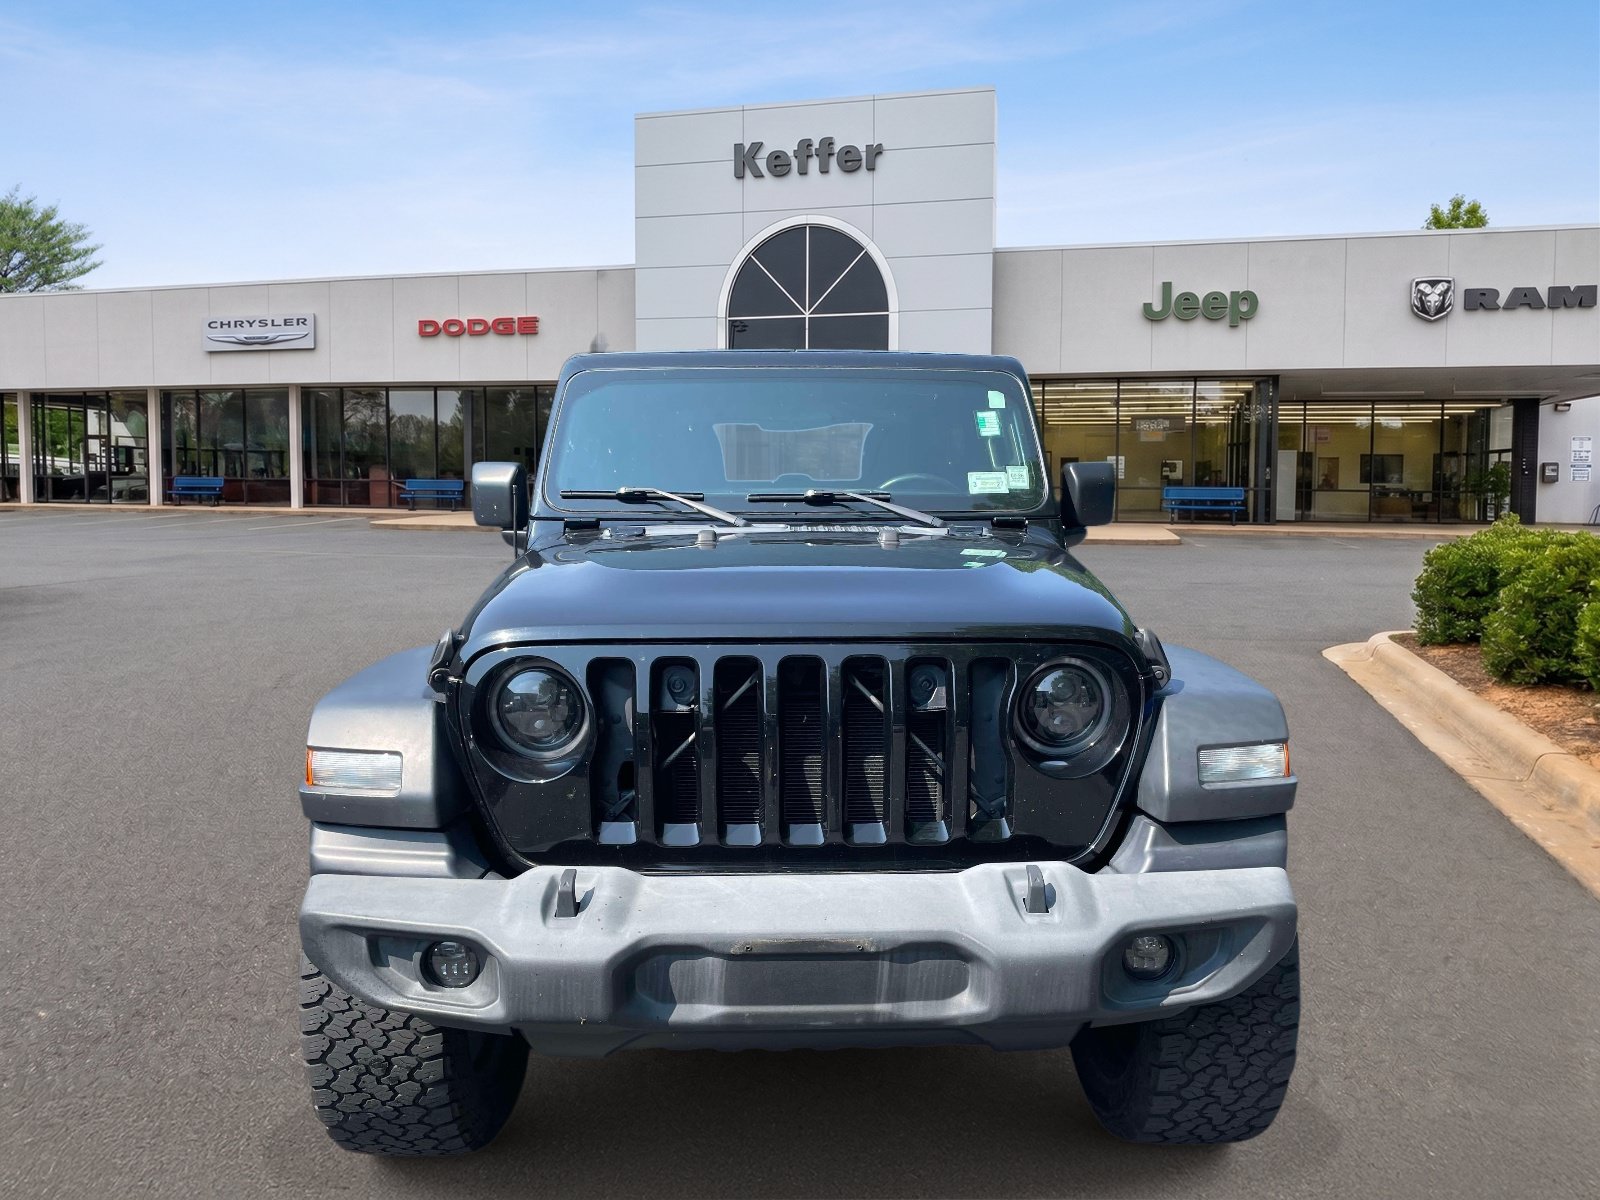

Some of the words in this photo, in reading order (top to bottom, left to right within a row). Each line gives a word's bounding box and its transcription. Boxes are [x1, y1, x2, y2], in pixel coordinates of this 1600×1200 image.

[734, 137, 883, 178] Keffer
[1143, 281, 1259, 327] Jeep
[1464, 285, 1598, 310] RAM
[208, 317, 307, 329] CHRYSLER
[418, 316, 541, 338] DODGE
